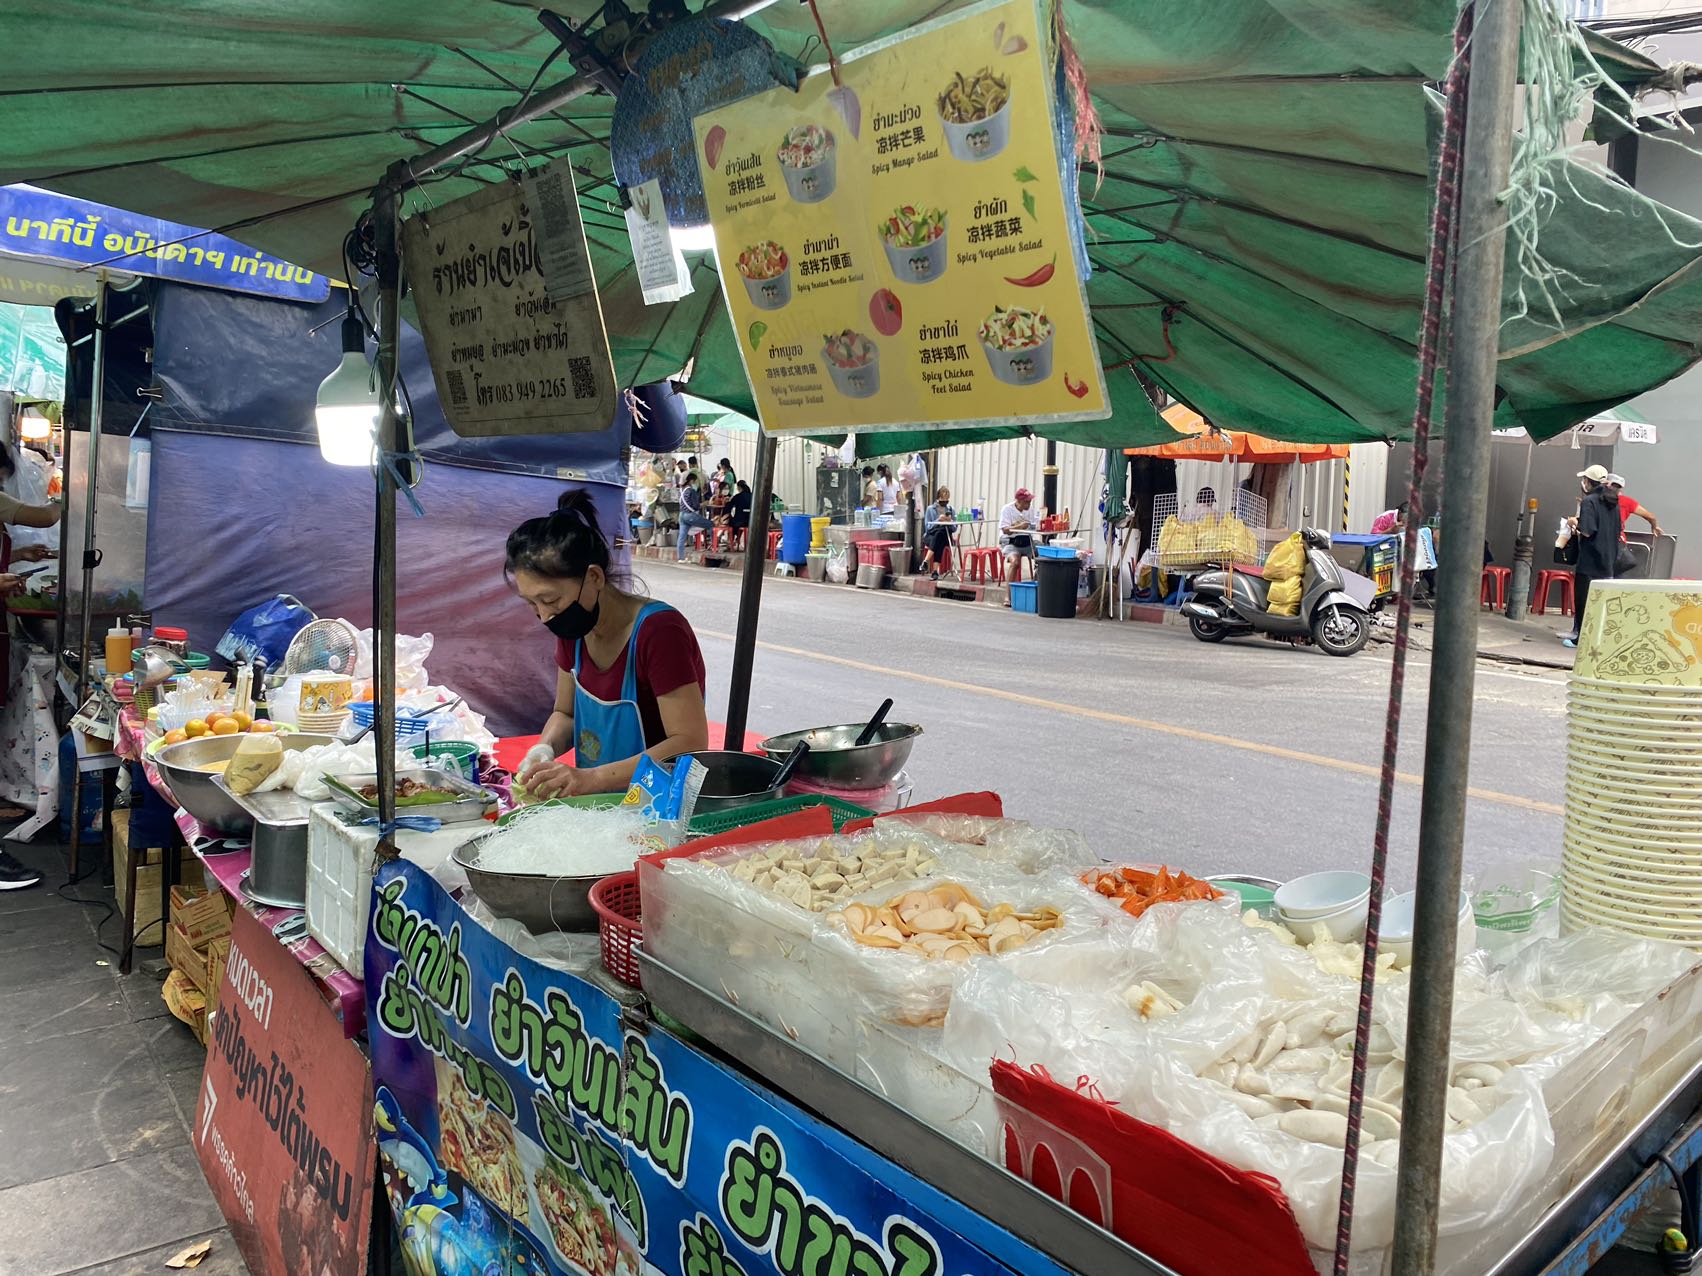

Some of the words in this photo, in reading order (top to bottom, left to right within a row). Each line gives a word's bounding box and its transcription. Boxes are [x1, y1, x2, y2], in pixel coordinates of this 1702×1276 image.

[873, 104, 921, 132] ยำมะม่วง
[876, 126, 926, 154] 凉拌芒果
[725, 152, 762, 177] ยำวุ้นเส้น
[872, 163, 890, 175] Spicy
[892, 155, 915, 170] Mango
[917, 148, 938, 162] Salad
[728, 172, 766, 196] 凉拌粉丝
[974, 198, 1008, 219] ยำผัก
[966, 217, 1023, 243] 凉拌蔬菜
[6, 214, 103, 247] นาทีนี้
[103, 229, 225, 269] อนันดาฯ
[230, 250, 315, 285] เท่านน
[803, 232, 840, 256] ยำมาม่า
[956, 251, 977, 264] Spicy
[978, 245, 1016, 260] Vegetable
[1018, 239, 1043, 251] Salad
[798, 252, 853, 276] 凉拌方便面
[797, 283, 811, 293] Spicy
[811, 280, 829, 290] Instant
[830, 277, 847, 286] Noodle
[449, 298, 483, 327] ยำมาม่า
[919, 320, 959, 341] ยำขาไก่
[491, 330, 531, 359] ยำมะม่วง
[768, 344, 803, 362] ยำหมูยอ
[919, 344, 970, 364] 凉拌鸡爪
[922, 370, 942, 384] Spicy
[944, 368, 974, 380] Chicken
[931, 384, 946, 394] Feet
[948, 382, 972, 393] Salad
[474, 373, 494, 408] โทร
[496, 383, 514, 404] 083
[517, 380, 537, 400] 949
[540, 377, 567, 399] 2265
[227, 940, 273, 1031] หมดเวลา
[490, 968, 693, 1187] ยำวุ้นเส้น
[212, 1122, 254, 1224] พรรคก้าวไกล
